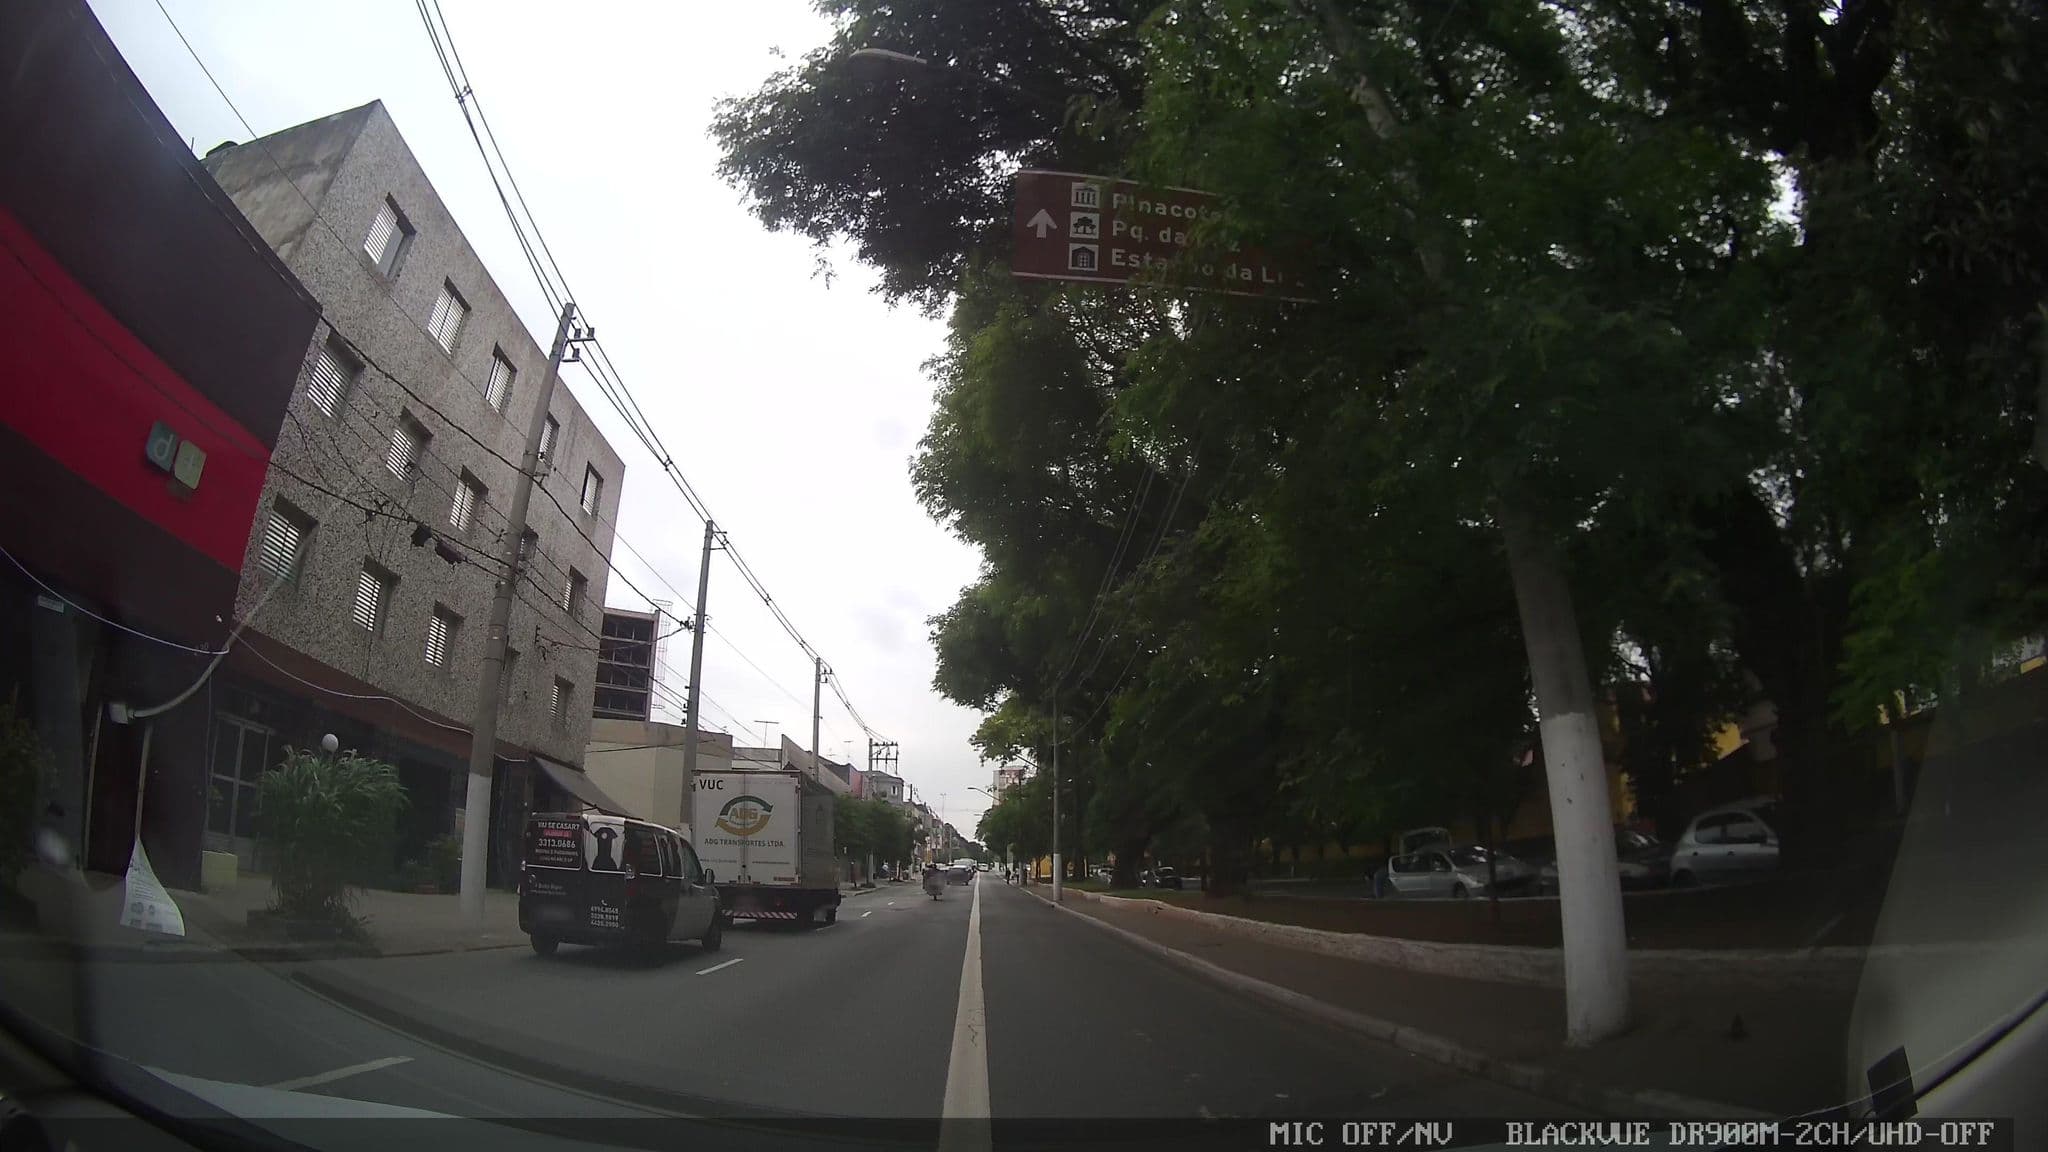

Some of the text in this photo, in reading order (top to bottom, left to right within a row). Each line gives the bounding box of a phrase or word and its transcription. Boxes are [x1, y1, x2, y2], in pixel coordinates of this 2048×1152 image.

[1111, 219, 1149, 243] Pq.
[1159, 226, 1186, 244] da
[1226, 262, 1253, 281] da
[699, 779, 724, 790] VUC
[538, 838, 576, 849] 3313.0686
[704, 838, 718, 846] ADG
[720, 838, 765, 847] TRANSPORTES
